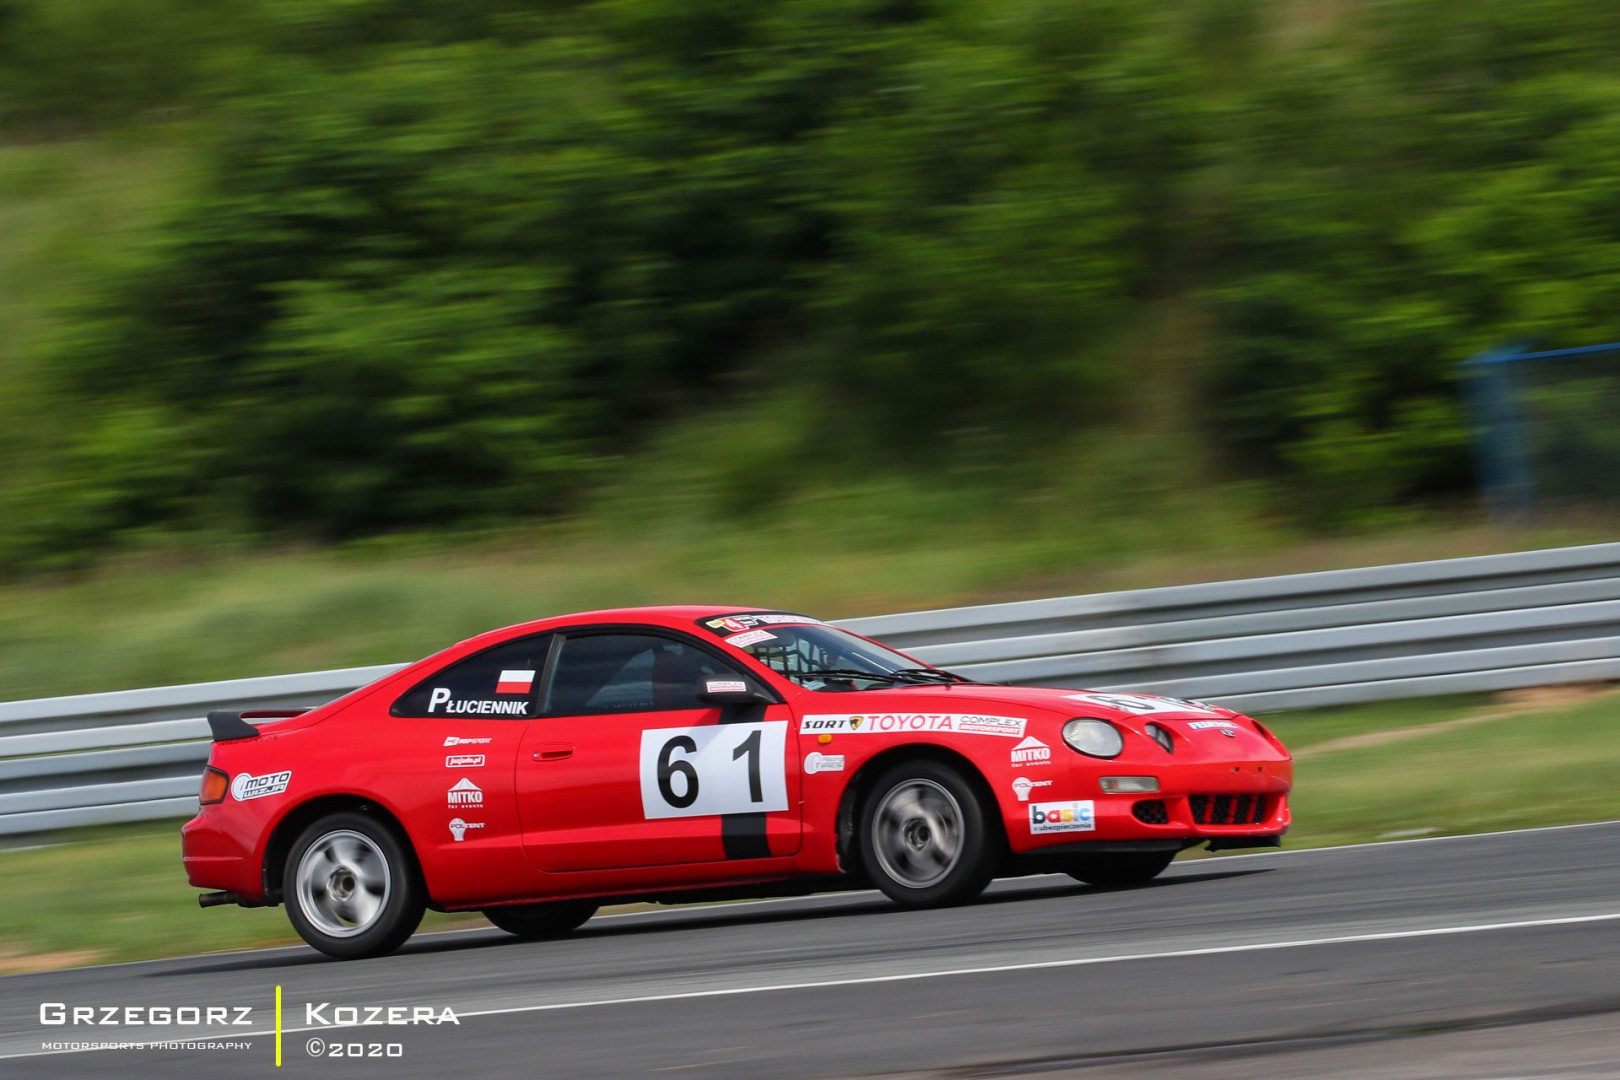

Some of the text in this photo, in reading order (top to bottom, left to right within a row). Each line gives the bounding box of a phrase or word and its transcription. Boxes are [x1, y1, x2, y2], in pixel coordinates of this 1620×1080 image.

[428, 687, 529, 714] PŁUCIENNIK
[803, 715, 953, 731] SORT TOYOTA
[960, 715, 1022, 728] COMPLEX
[1011, 747, 1051, 762] MITKO
[657, 730, 763, 808] 61
[245, 772, 290, 790] MOTO
[447, 791, 483, 804] MITKO
[1032, 802, 1091, 825] basic
